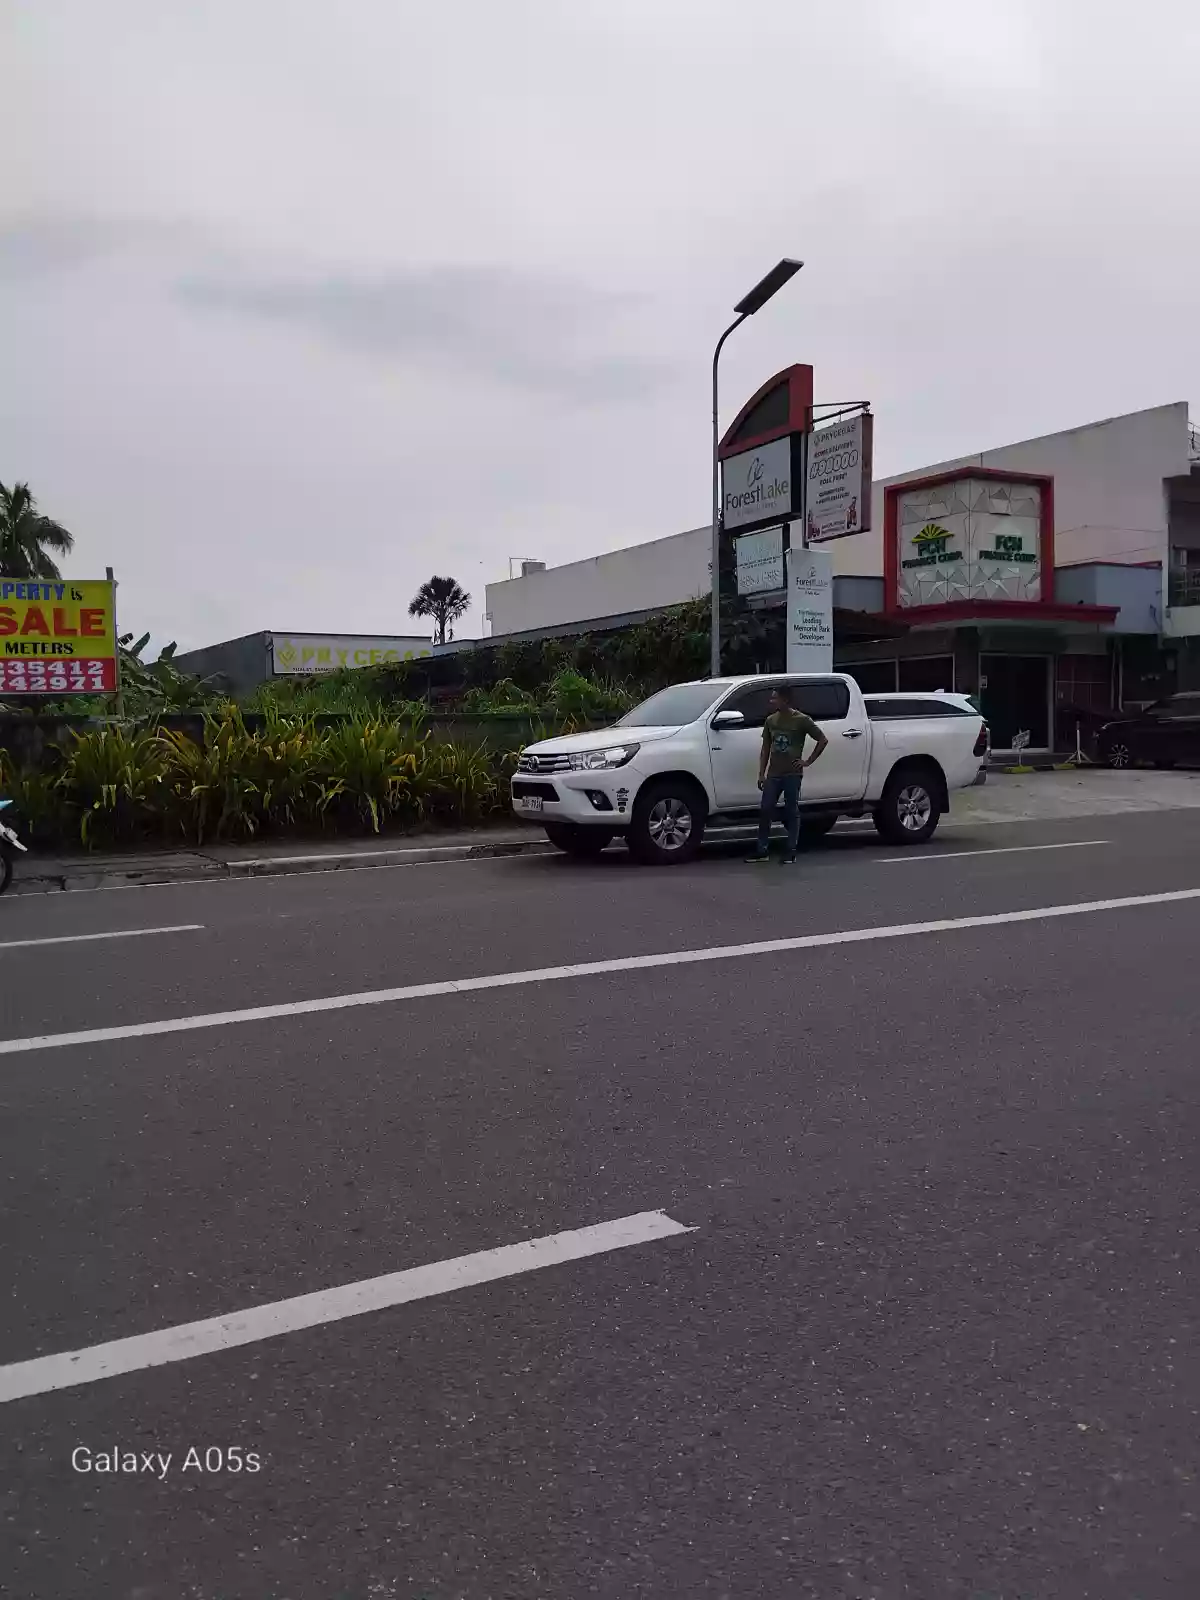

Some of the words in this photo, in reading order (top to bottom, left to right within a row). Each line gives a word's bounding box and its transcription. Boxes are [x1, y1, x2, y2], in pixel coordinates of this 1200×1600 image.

[726, 478, 789, 512] ForestLake
[0, 583, 65, 600] PERTY
[71, 588, 83, 601] is
[0, 607, 105, 636] SALE
[5, 642, 74, 655] METERS
[0, 661, 104, 675] 35412
